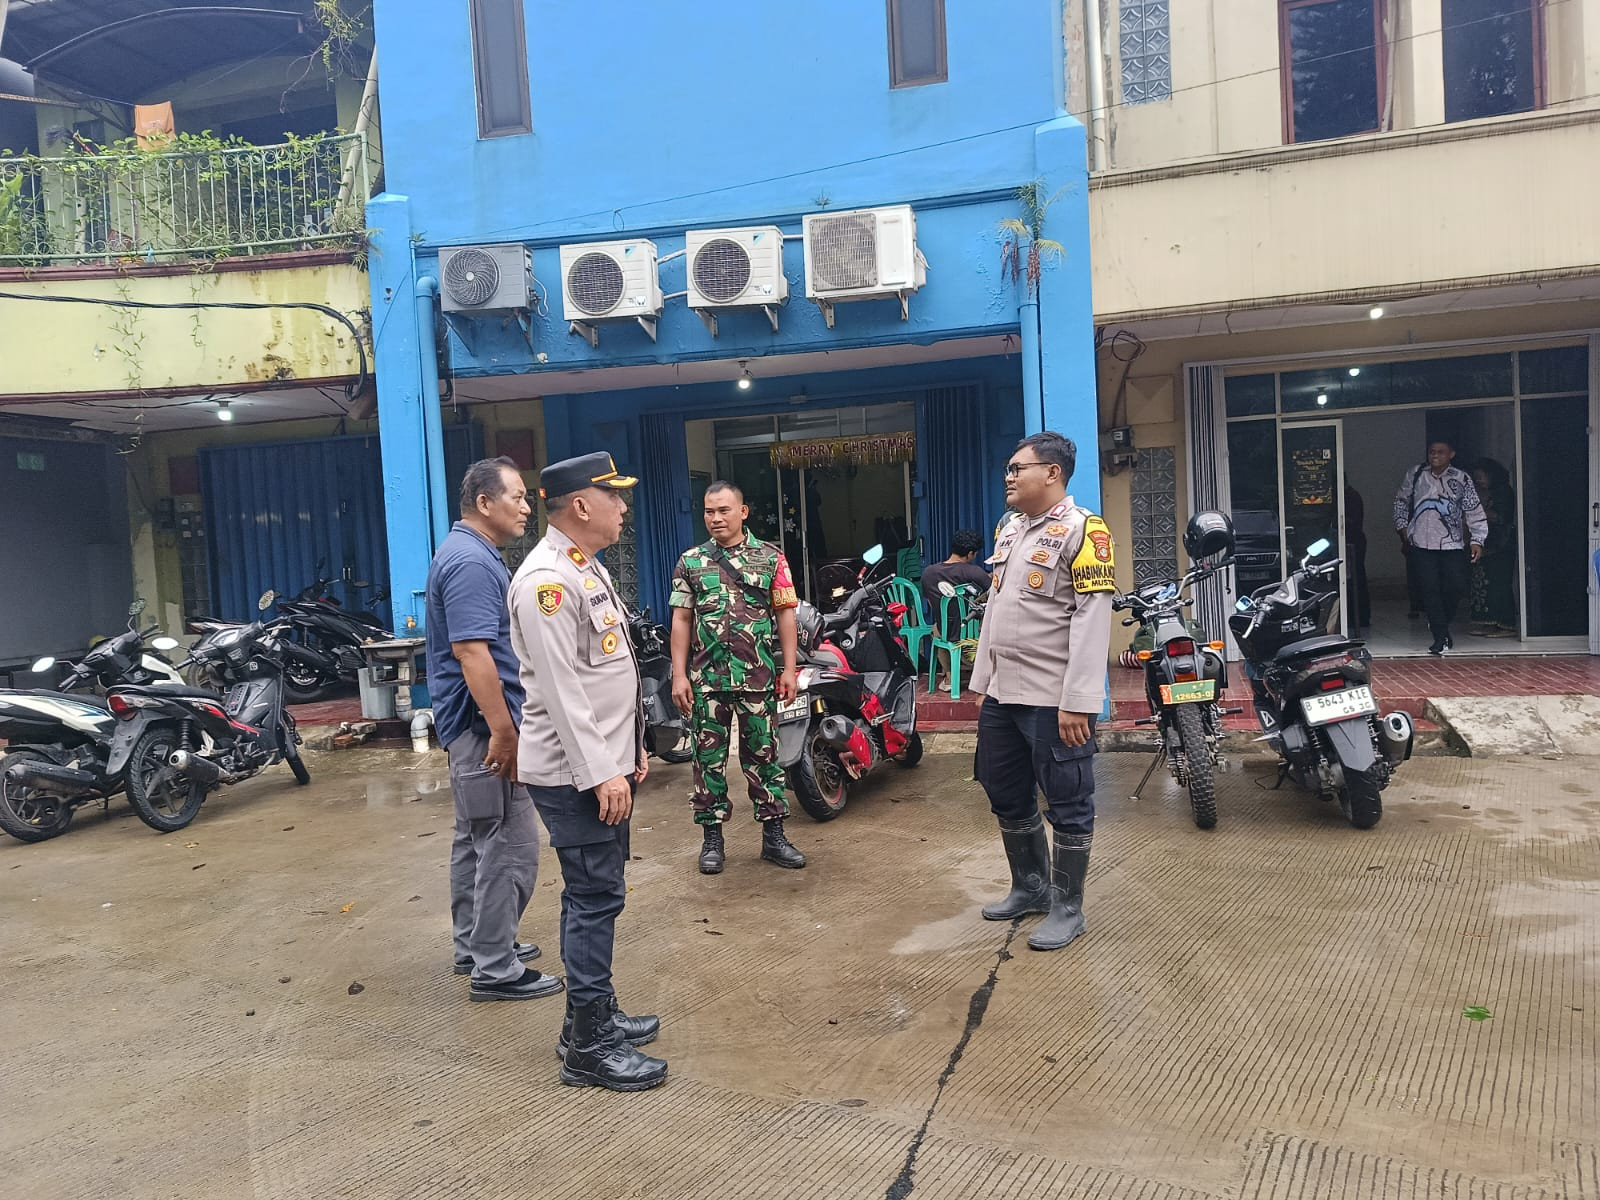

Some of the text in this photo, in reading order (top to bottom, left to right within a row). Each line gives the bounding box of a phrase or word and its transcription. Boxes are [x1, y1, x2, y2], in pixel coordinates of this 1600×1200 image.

[792, 437, 915, 457] MERRY CHRISTMAS
[1036, 537, 1063, 549] POLRI
[1305, 688, 1369, 712] B 5643 KIE
